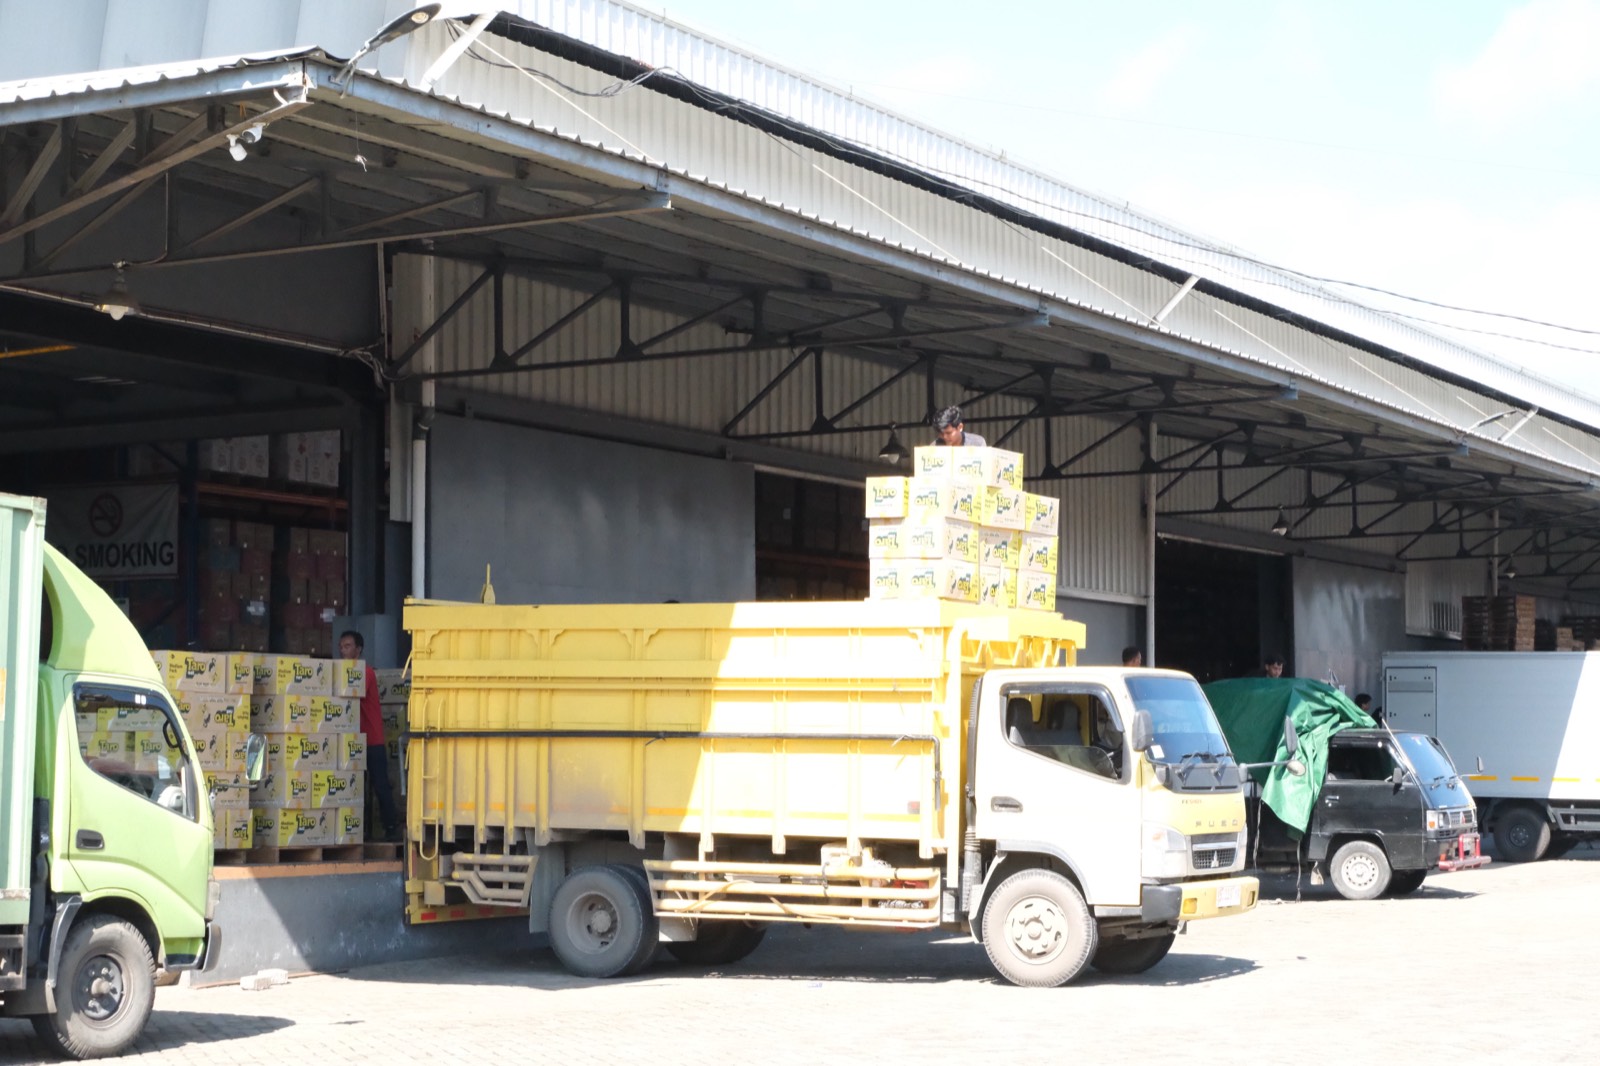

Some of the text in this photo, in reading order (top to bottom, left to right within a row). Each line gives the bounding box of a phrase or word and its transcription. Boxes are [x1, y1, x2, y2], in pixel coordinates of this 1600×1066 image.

[75, 541, 175, 568] SMOKING
[185, 657, 206, 675] Taro
[234, 664, 250, 677] Taro
[254, 665, 273, 679] Taro
[293, 662, 314, 680] Taro
[347, 668, 362, 681] Taro
[214, 709, 235, 726] Taro
[290, 703, 307, 717] Taro
[324, 701, 342, 719] Taro
[300, 738, 319, 756] Taro
[348, 742, 363, 755] Taro
[291, 778, 308, 793] Taro
[328, 775, 347, 793] Taro
[296, 814, 316, 832] Taro
[344, 815, 360, 830] Taro
[234, 826, 248, 840] Taro
